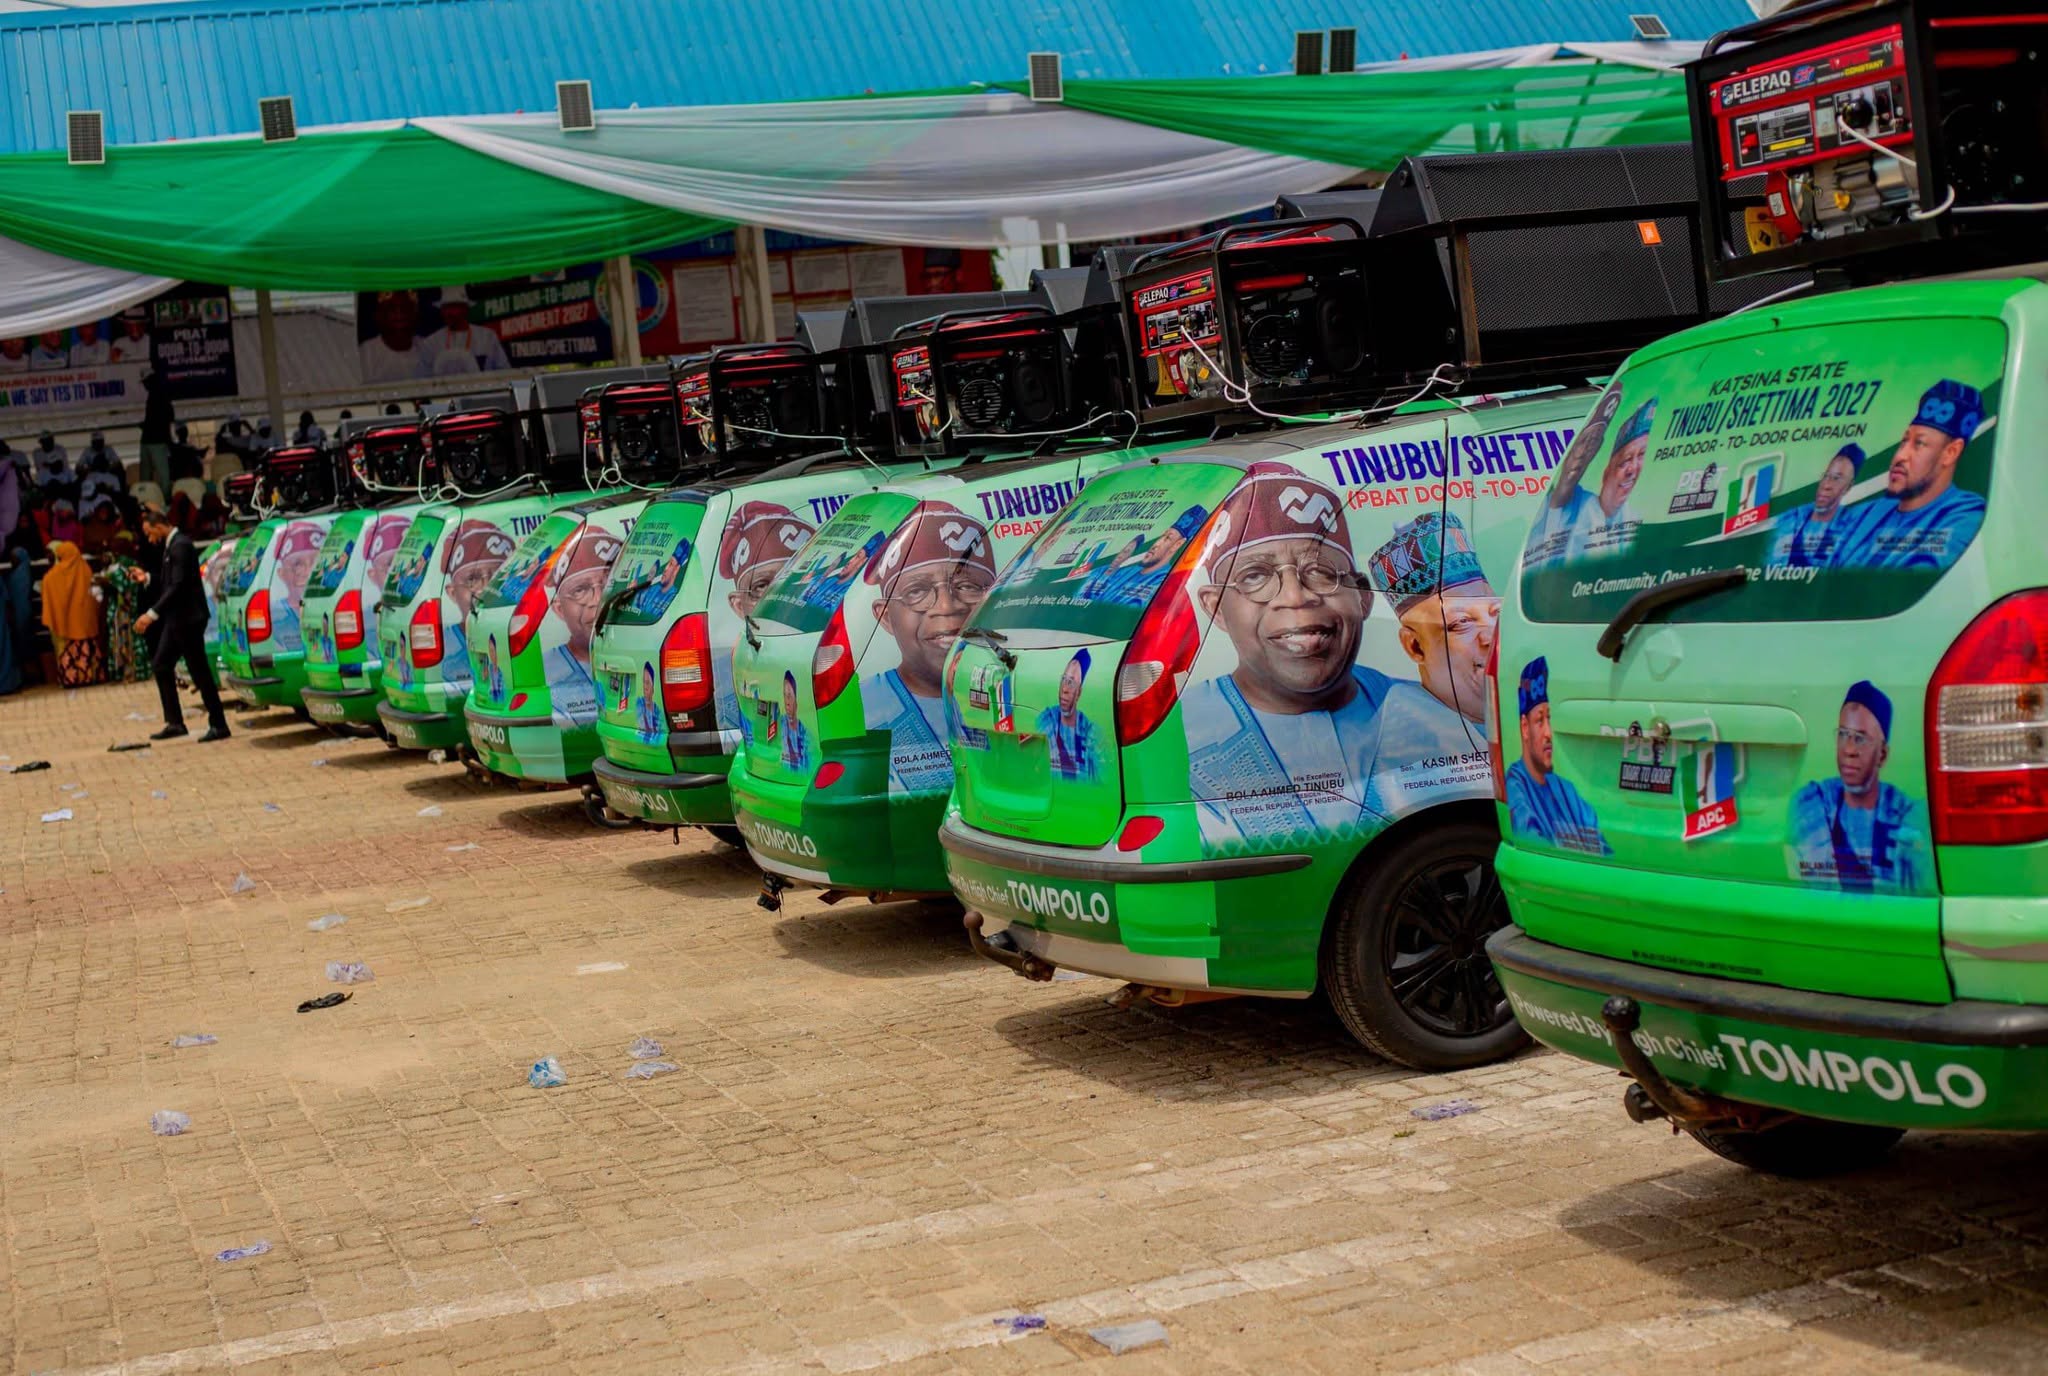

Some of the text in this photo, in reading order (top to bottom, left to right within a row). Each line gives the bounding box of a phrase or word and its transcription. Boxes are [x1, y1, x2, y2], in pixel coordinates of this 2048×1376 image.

[1733, 70, 1791, 99] ELEPAQ
[1143, 287, 1169, 303] ELEPAQ
[1709, 361, 1849, 397] KATSINA STATE
[1664, 380, 1883, 441] TINUBU/SHETTIMA 2027
[1653, 445, 1682, 462] PBAT
[1683, 441, 1717, 457] DOOR
[1749, 430, 1790, 447] DOOR
[1792, 423, 1868, 442] CAMPAIGN
[808, 494, 850, 524] TIN
[1346, 487, 1409, 511] (PBAT
[1415, 480, 1476, 504] DOOR
[1732, 510, 1759, 529] APC
[1572, 580, 1593, 598] One
[1764, 562, 1820, 584] Victory
[894, 754, 919, 765] BOLA
[1422, 755, 1458, 769] KASIM
[1226, 778, 1345, 802] BOLA AHMED TINUBU
[1306, 771, 1342, 782] Excellency
[1403, 780, 1439, 790] FEDERAL
[1440, 774, 1475, 785] REPUBLIC
[1230, 805, 1264, 815] FEDERAL
[1696, 807, 1726, 831] APC
[755, 822, 817, 858] TOMPOLO
[1007, 880, 1110, 924] TOMPOLO
[1511, 991, 1585, 1034] Powered
[1583, 1016, 1613, 1047] By
[1664, 1036, 1728, 1070] Chief
[1718, 1033, 1987, 1109] TOMPOLO
